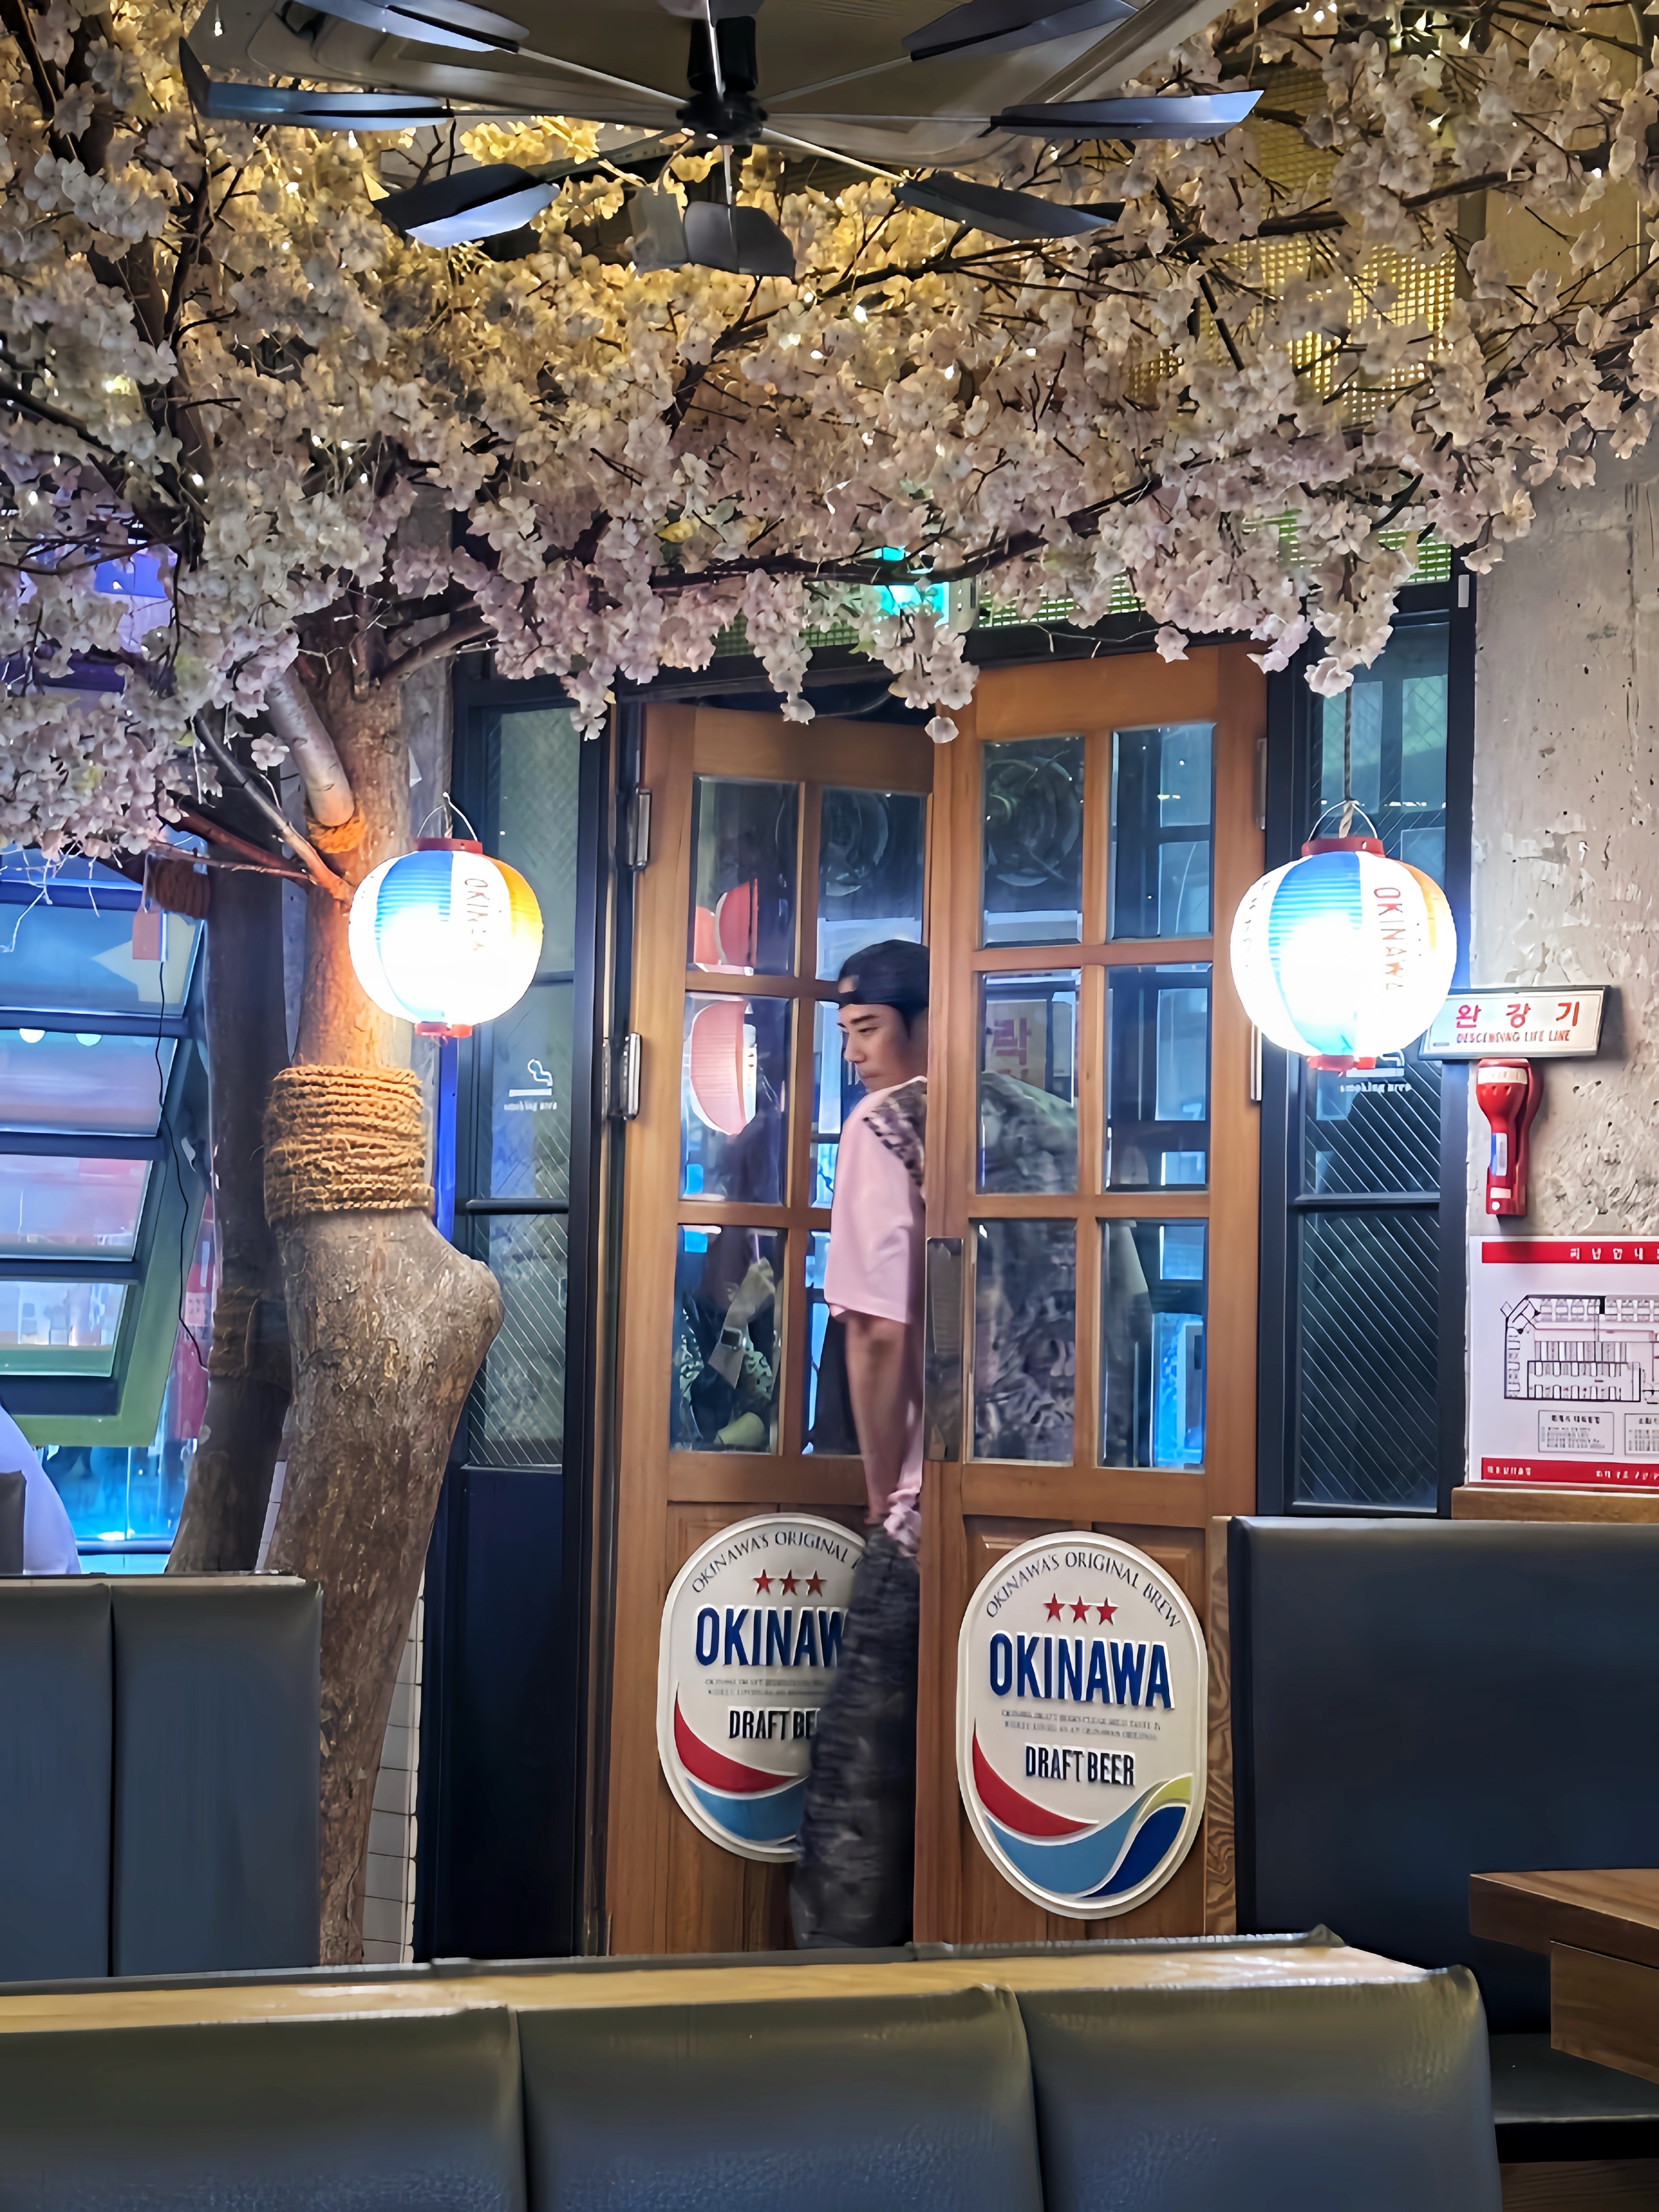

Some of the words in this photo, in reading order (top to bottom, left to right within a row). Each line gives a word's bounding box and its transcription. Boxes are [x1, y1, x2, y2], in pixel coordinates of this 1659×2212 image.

[1373, 887, 1407, 990] OKINAWA
[986, 1553, 1060, 1618] OKINAWA'S
[1065, 1552, 1139, 1589] ORIGINAL
[1142, 1583, 1181, 1627] BREW
[695, 1607, 847, 1667] OKINAW
[990, 1632, 1174, 1709] OKINAWA
[729, 1709, 791, 1740] DRAFT
[793, 1710, 819, 1740] BE
[1025, 1744, 1083, 1780] DRAFT
[1087, 1751, 1135, 1786] BEER
